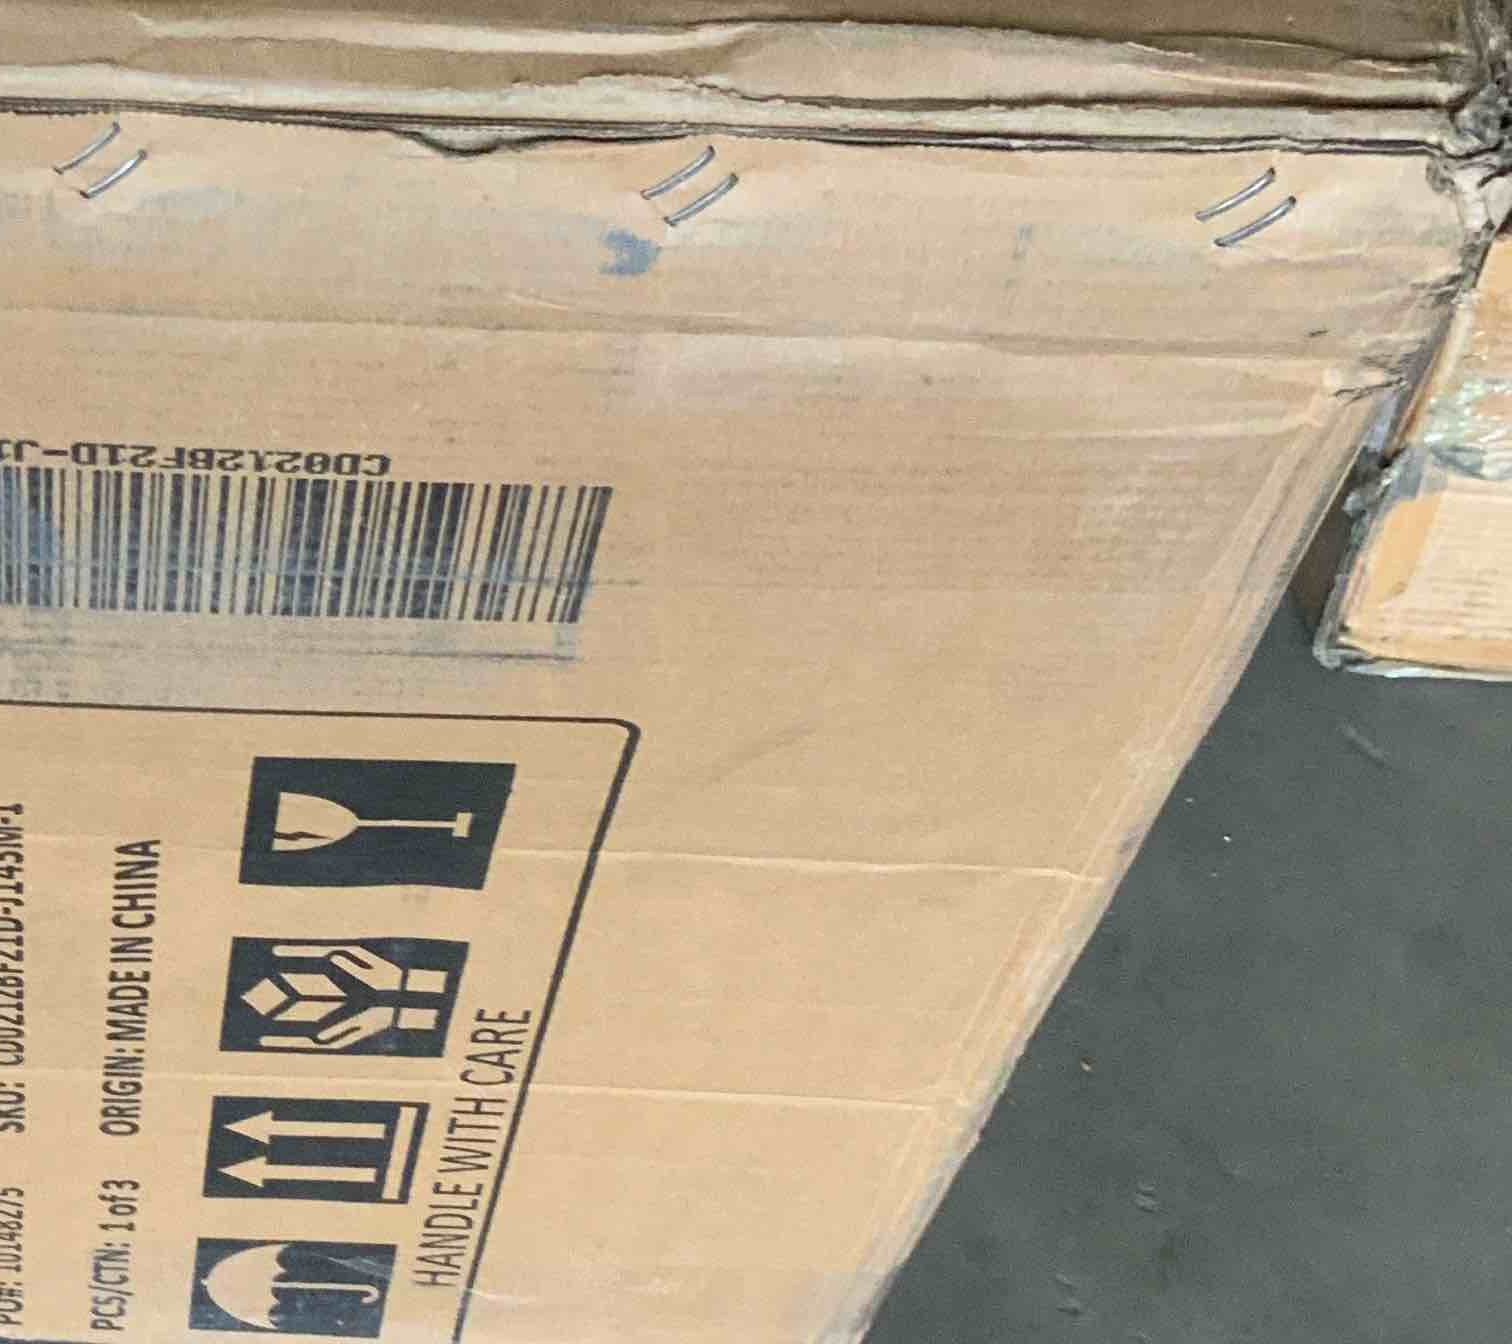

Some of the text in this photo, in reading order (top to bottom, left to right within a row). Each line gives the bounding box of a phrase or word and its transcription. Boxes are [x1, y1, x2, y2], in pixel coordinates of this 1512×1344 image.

[99, 838, 162, 1137] ORIGIN: MADE IN CHINA
[88, 1241, 134, 1331] PCS/CTN:
[411, 1008, 532, 1288] HANDLE WITH CARE
